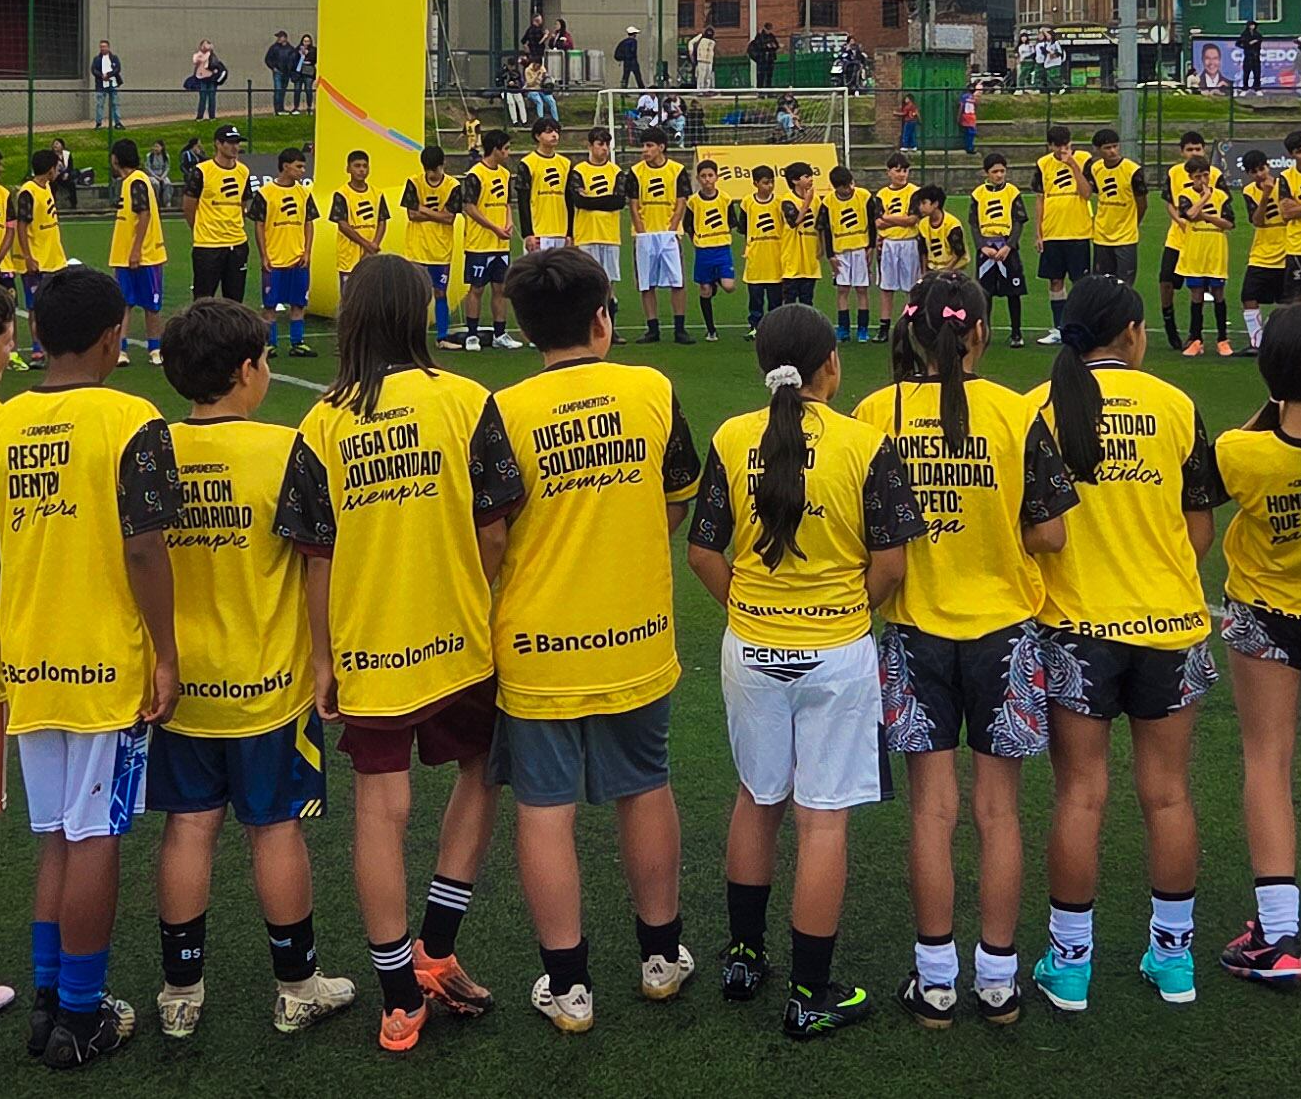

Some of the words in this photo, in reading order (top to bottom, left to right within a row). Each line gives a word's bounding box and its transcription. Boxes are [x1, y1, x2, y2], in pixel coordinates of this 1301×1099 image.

[1231, 48, 1298, 62] CCEDO
[338, 429, 386, 464] JUEGA
[387, 422, 419, 451] CON
[532, 417, 585, 455] JUEGA
[587, 410, 622, 439] CON
[342, 451, 442, 492] SOLIDARIDAD
[537, 438, 647, 481] SOLIDARIDAD
[1097, 459, 1164, 486] rtidos
[204, 480, 233, 502] CON
[540, 466, 644, 500] siempre
[907, 464, 999, 491] LIDARIDAD,
[341, 480, 439, 511] siempre
[11, 506, 26, 533] y
[925, 518, 965, 543] ega
[1269, 513, 1301, 534] QUE
[164, 531, 250, 553] siempre
[536, 613, 669, 655] Bancolombia
[1080, 611, 1205, 639] Bancolombia
[742, 647, 822, 665] PENALT
[179, 670, 294, 700] ancolombia
